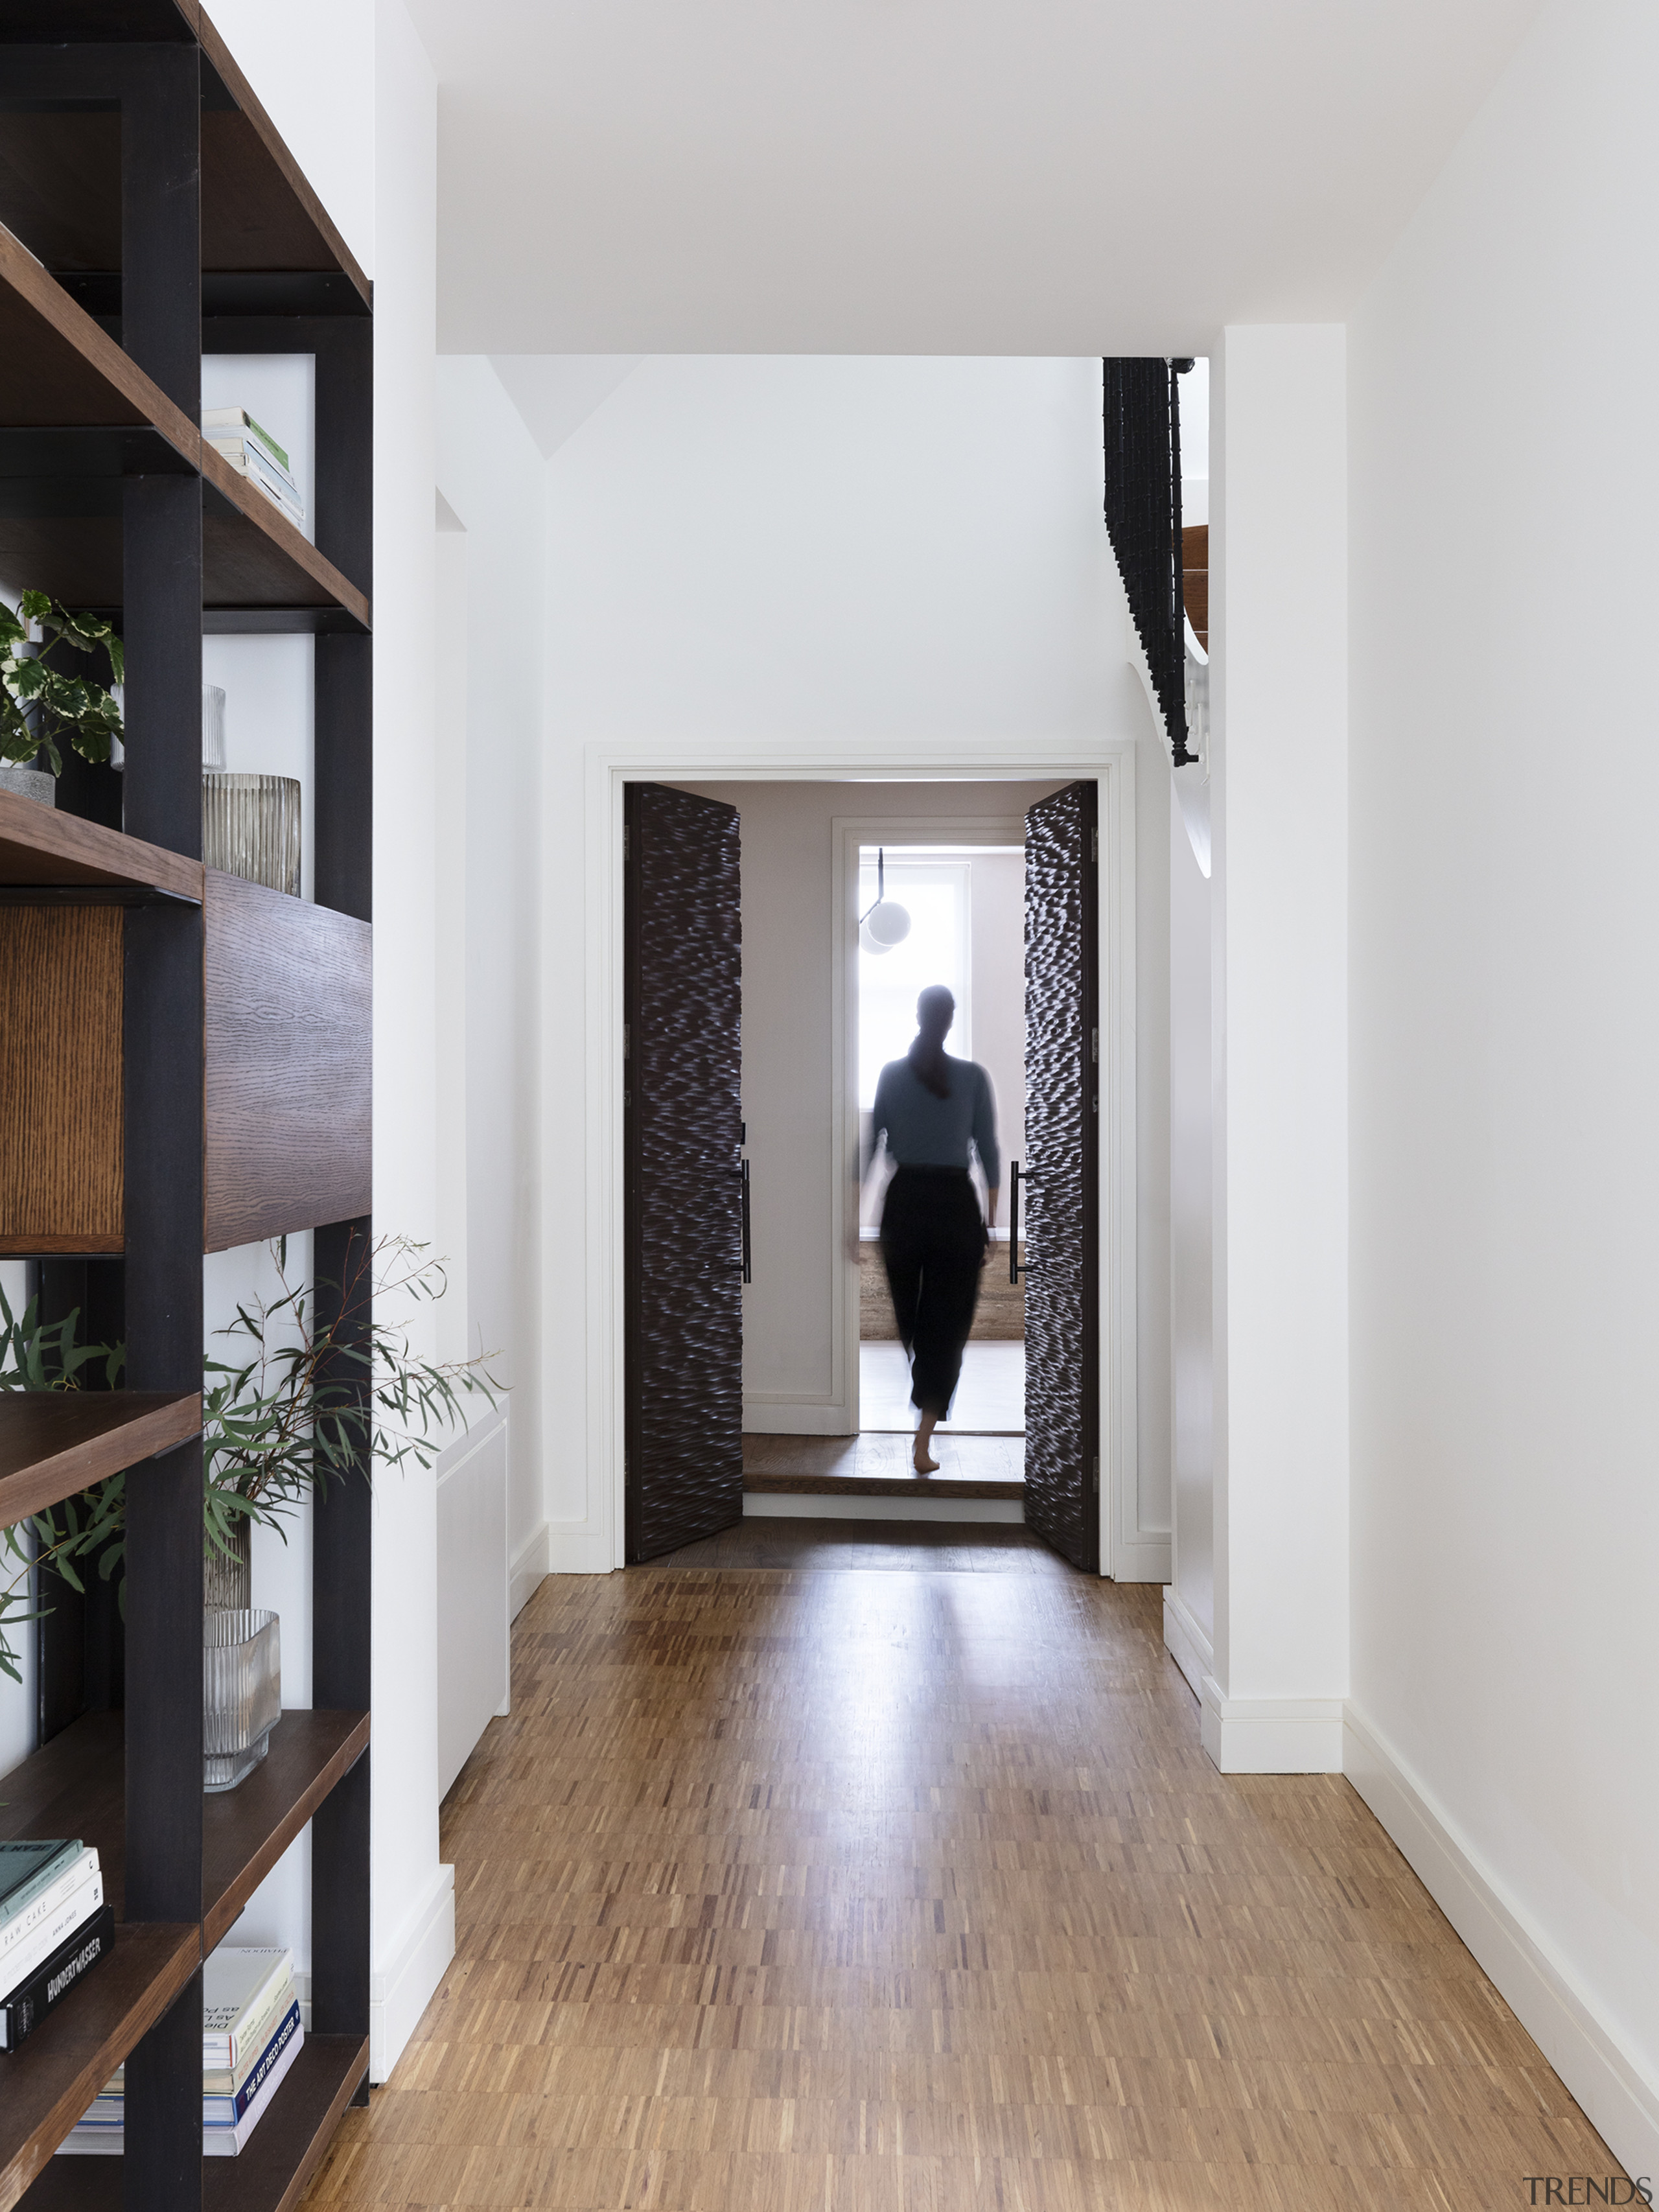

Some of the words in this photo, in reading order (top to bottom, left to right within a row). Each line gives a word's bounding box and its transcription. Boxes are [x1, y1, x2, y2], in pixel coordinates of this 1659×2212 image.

[4, 1923, 21, 1945] RAW
[26, 1902, 46, 1926] CAKE
[52, 1922, 64, 1937] ANNA
[65, 1909, 77, 1926] JONES
[47, 1937, 101, 2003] HUNDERTWASSER
[246, 2078, 256, 2101] THE
[257, 2063, 266, 2084] ART
[266, 2042, 279, 2071] DECO
[279, 2016, 294, 2051] POSTER
